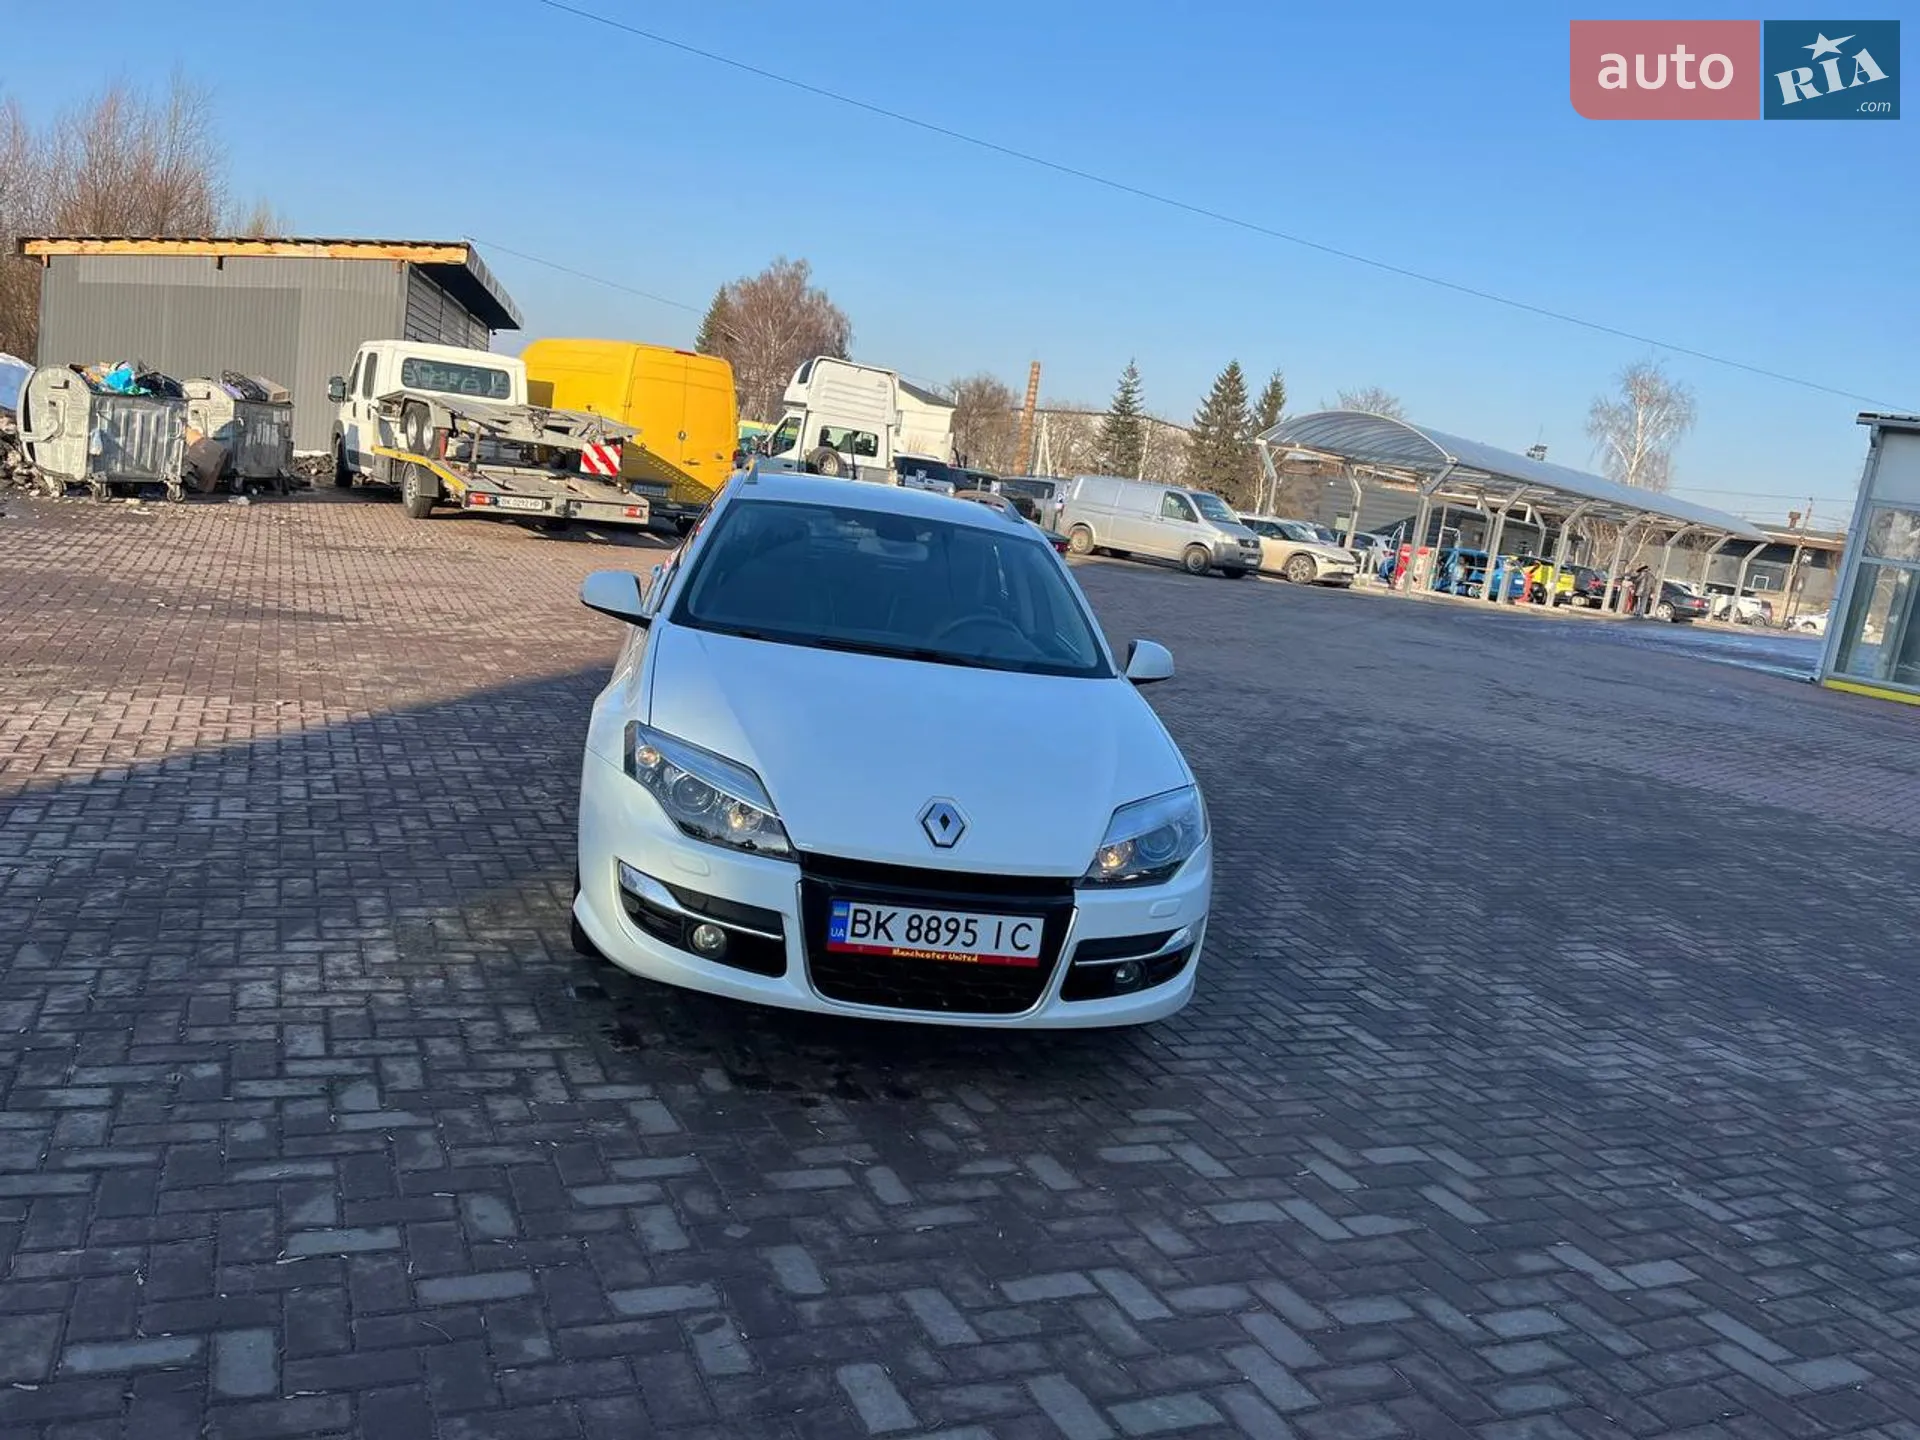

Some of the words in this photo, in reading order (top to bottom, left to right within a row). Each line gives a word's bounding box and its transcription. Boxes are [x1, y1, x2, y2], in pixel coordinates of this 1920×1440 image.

[830, 927, 845, 938] UA
[850, 908, 898, 942] BK
[905, 914, 978, 947] 8895
[994, 921, 1033, 951] IC
[948, 952, 978, 962] United
